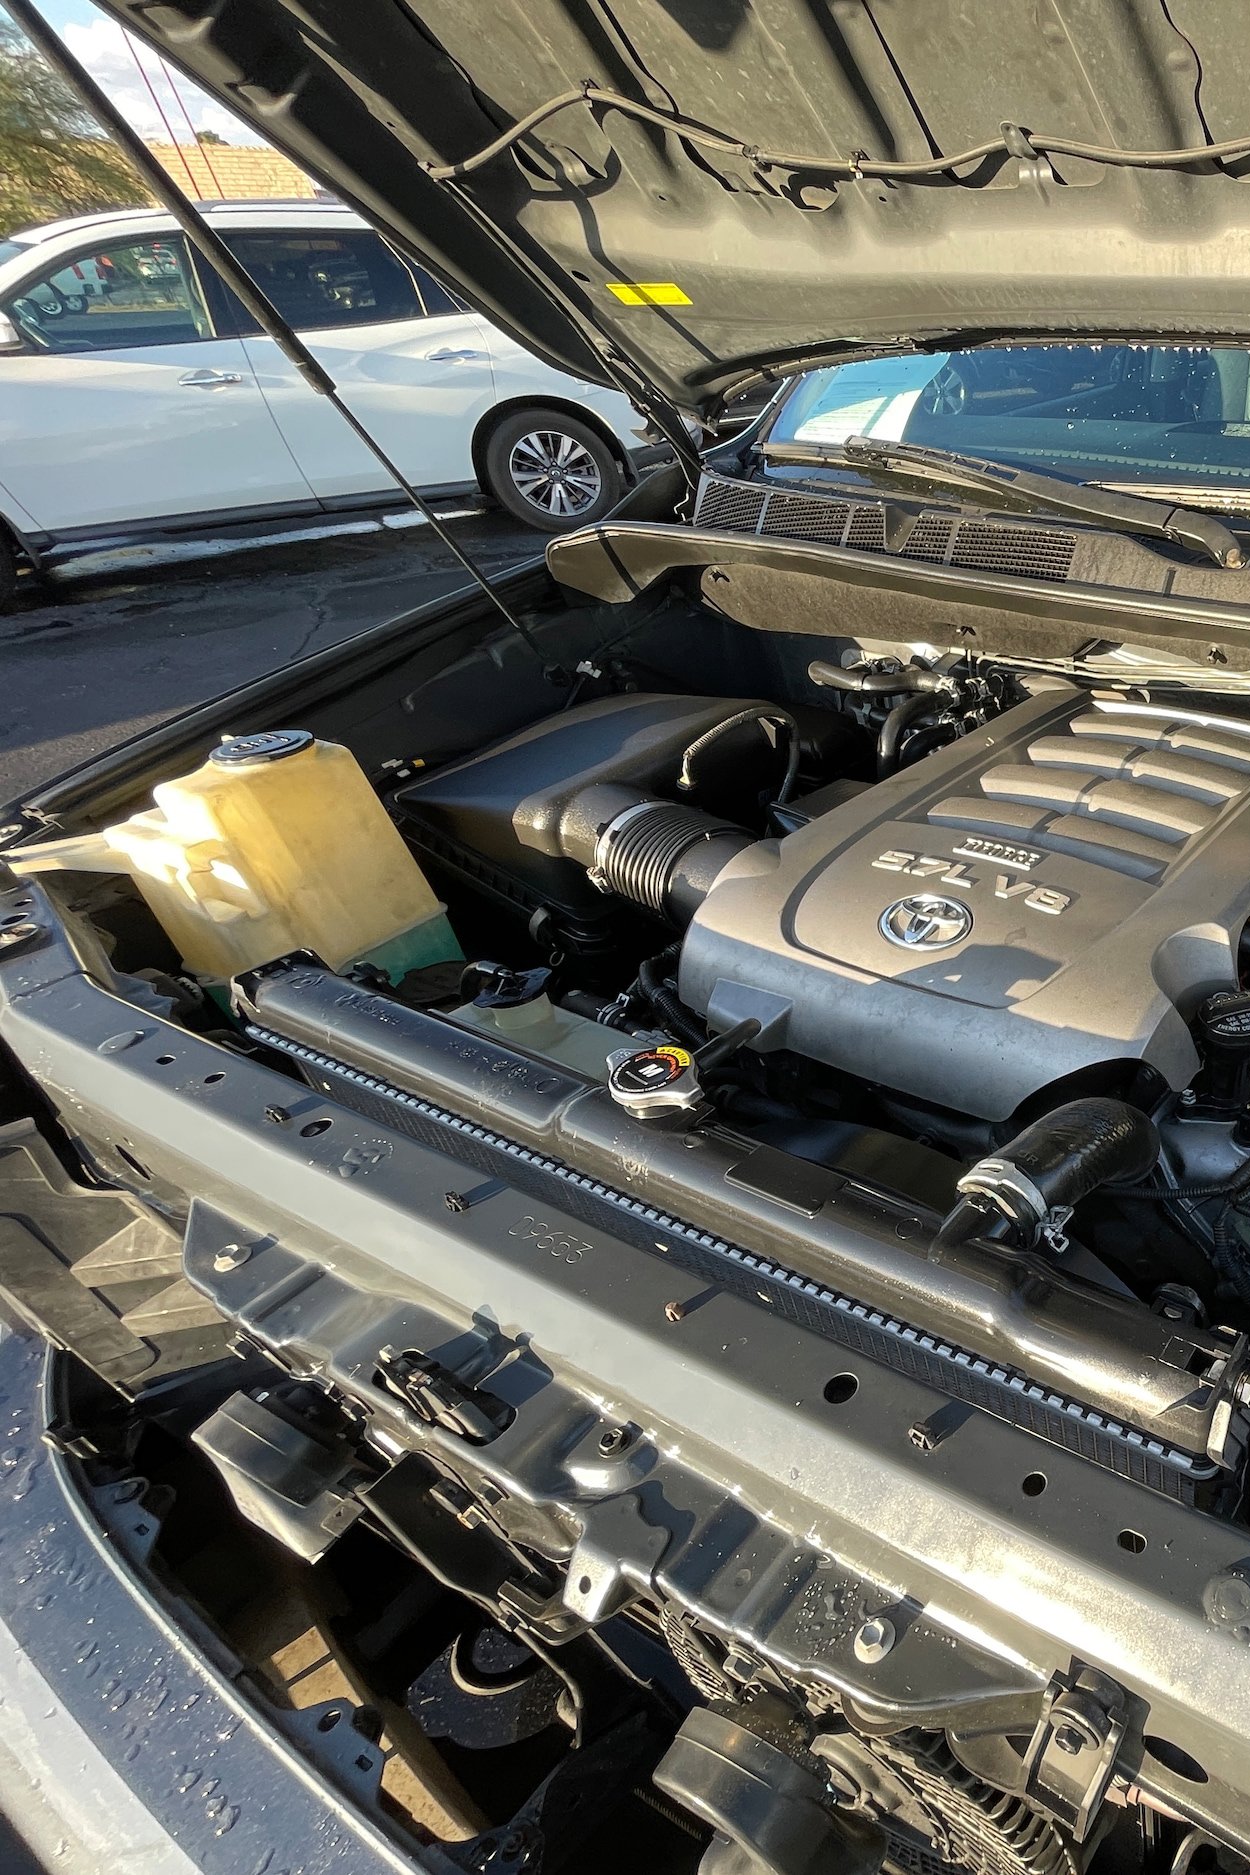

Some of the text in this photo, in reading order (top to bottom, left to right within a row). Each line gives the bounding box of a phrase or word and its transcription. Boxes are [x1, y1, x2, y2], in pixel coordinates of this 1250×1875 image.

[871, 850, 1071, 915] 5.7L V8
[1217, 1023, 1240, 1032] ENERGY
